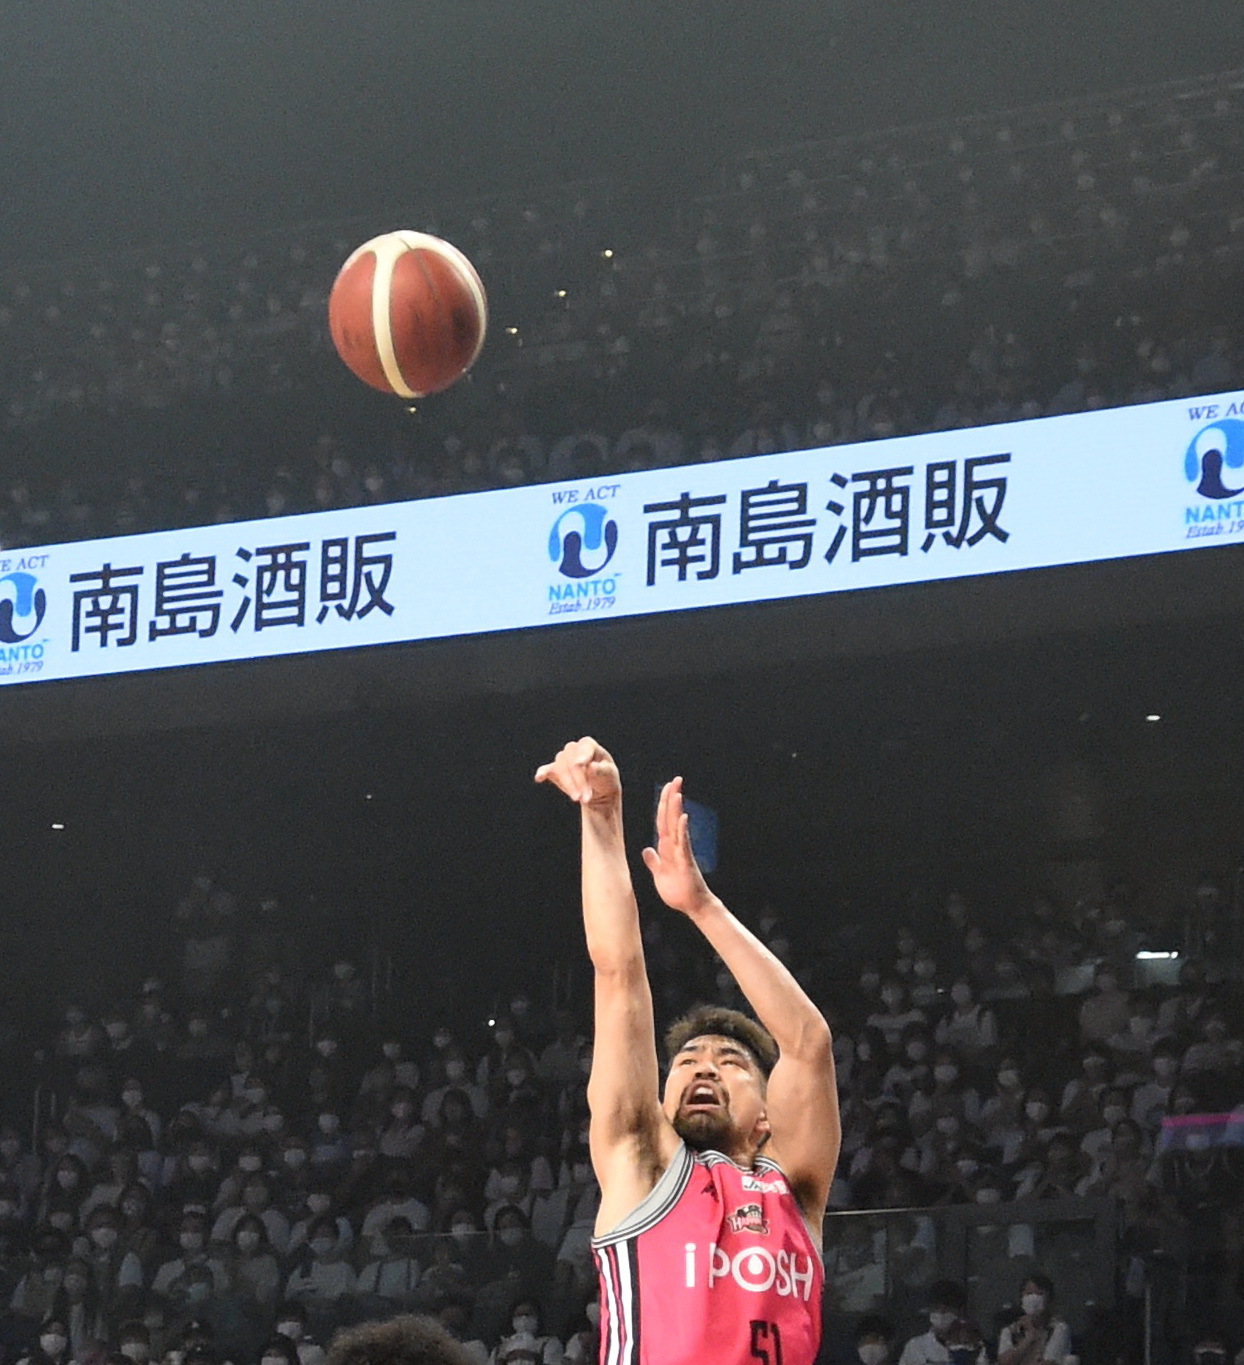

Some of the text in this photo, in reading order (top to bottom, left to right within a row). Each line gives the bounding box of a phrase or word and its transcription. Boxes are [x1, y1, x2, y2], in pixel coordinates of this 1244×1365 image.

[1188, 405, 1219, 421] WE
[552, 485, 621, 504] WE ACT
[643, 453, 1012, 586] 南島酒販
[16, 555, 49, 570] ACT
[69, 531, 397, 652] 南島酒販
[548, 579, 616, 601] NANTO
